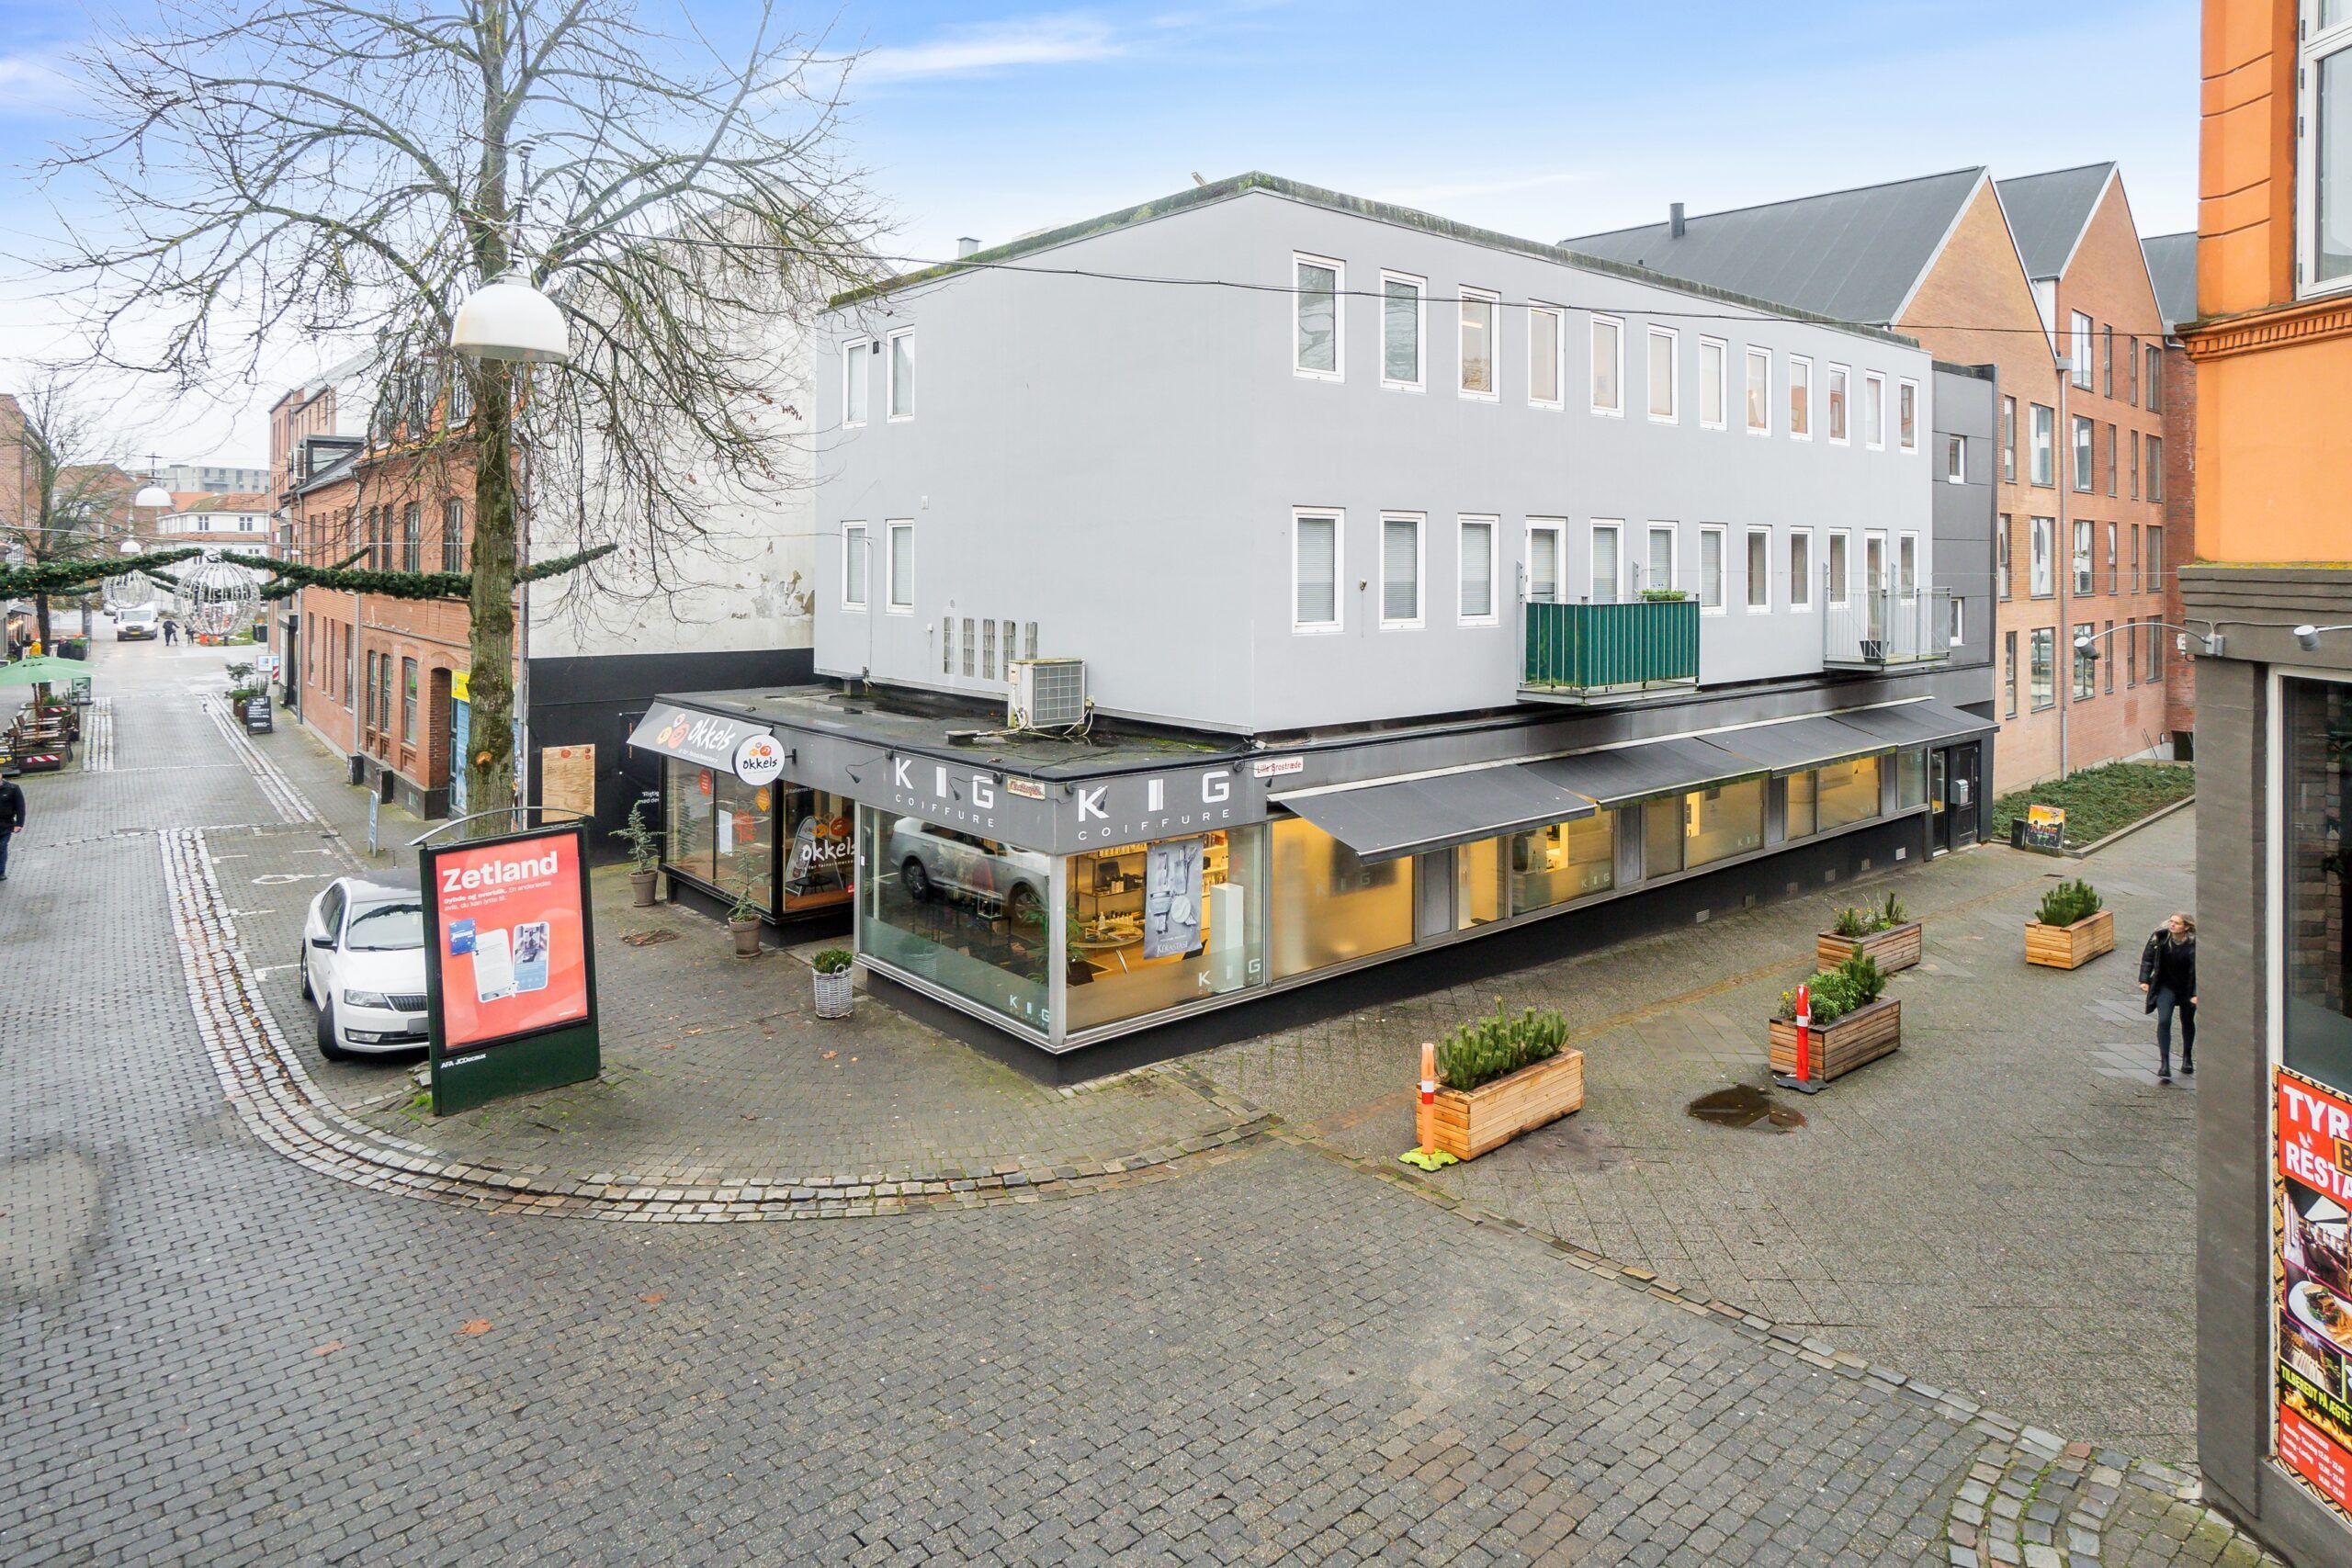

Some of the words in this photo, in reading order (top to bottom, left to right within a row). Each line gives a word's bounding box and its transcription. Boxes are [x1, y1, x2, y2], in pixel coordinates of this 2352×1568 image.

[687, 717, 737, 751] okkels
[742, 757, 777, 770] okkels
[895, 794, 994, 828] COIFFURE
[1078, 808, 1230, 840] COIFFURE
[442, 851, 559, 893] Zetland
